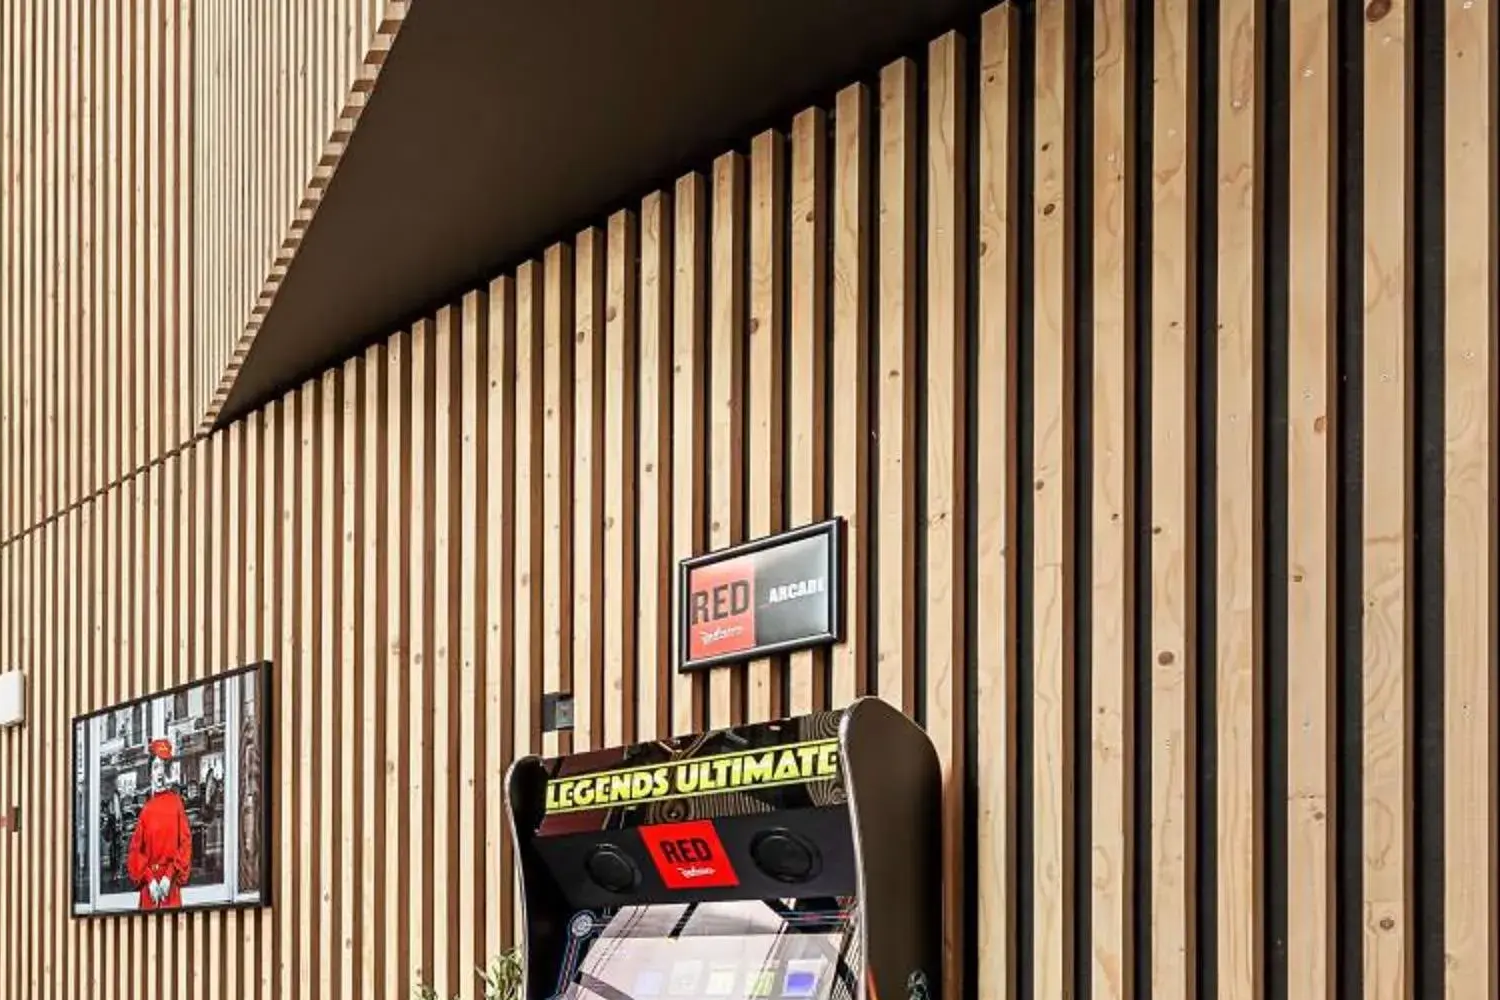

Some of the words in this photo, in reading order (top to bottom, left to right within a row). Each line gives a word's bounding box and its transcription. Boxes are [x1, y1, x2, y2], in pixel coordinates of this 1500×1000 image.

[691, 579, 749, 625] RED
[546, 767, 670, 808] LEGENDS
[675, 743, 838, 793] ULTIMATE
[660, 837, 712, 864] RED
